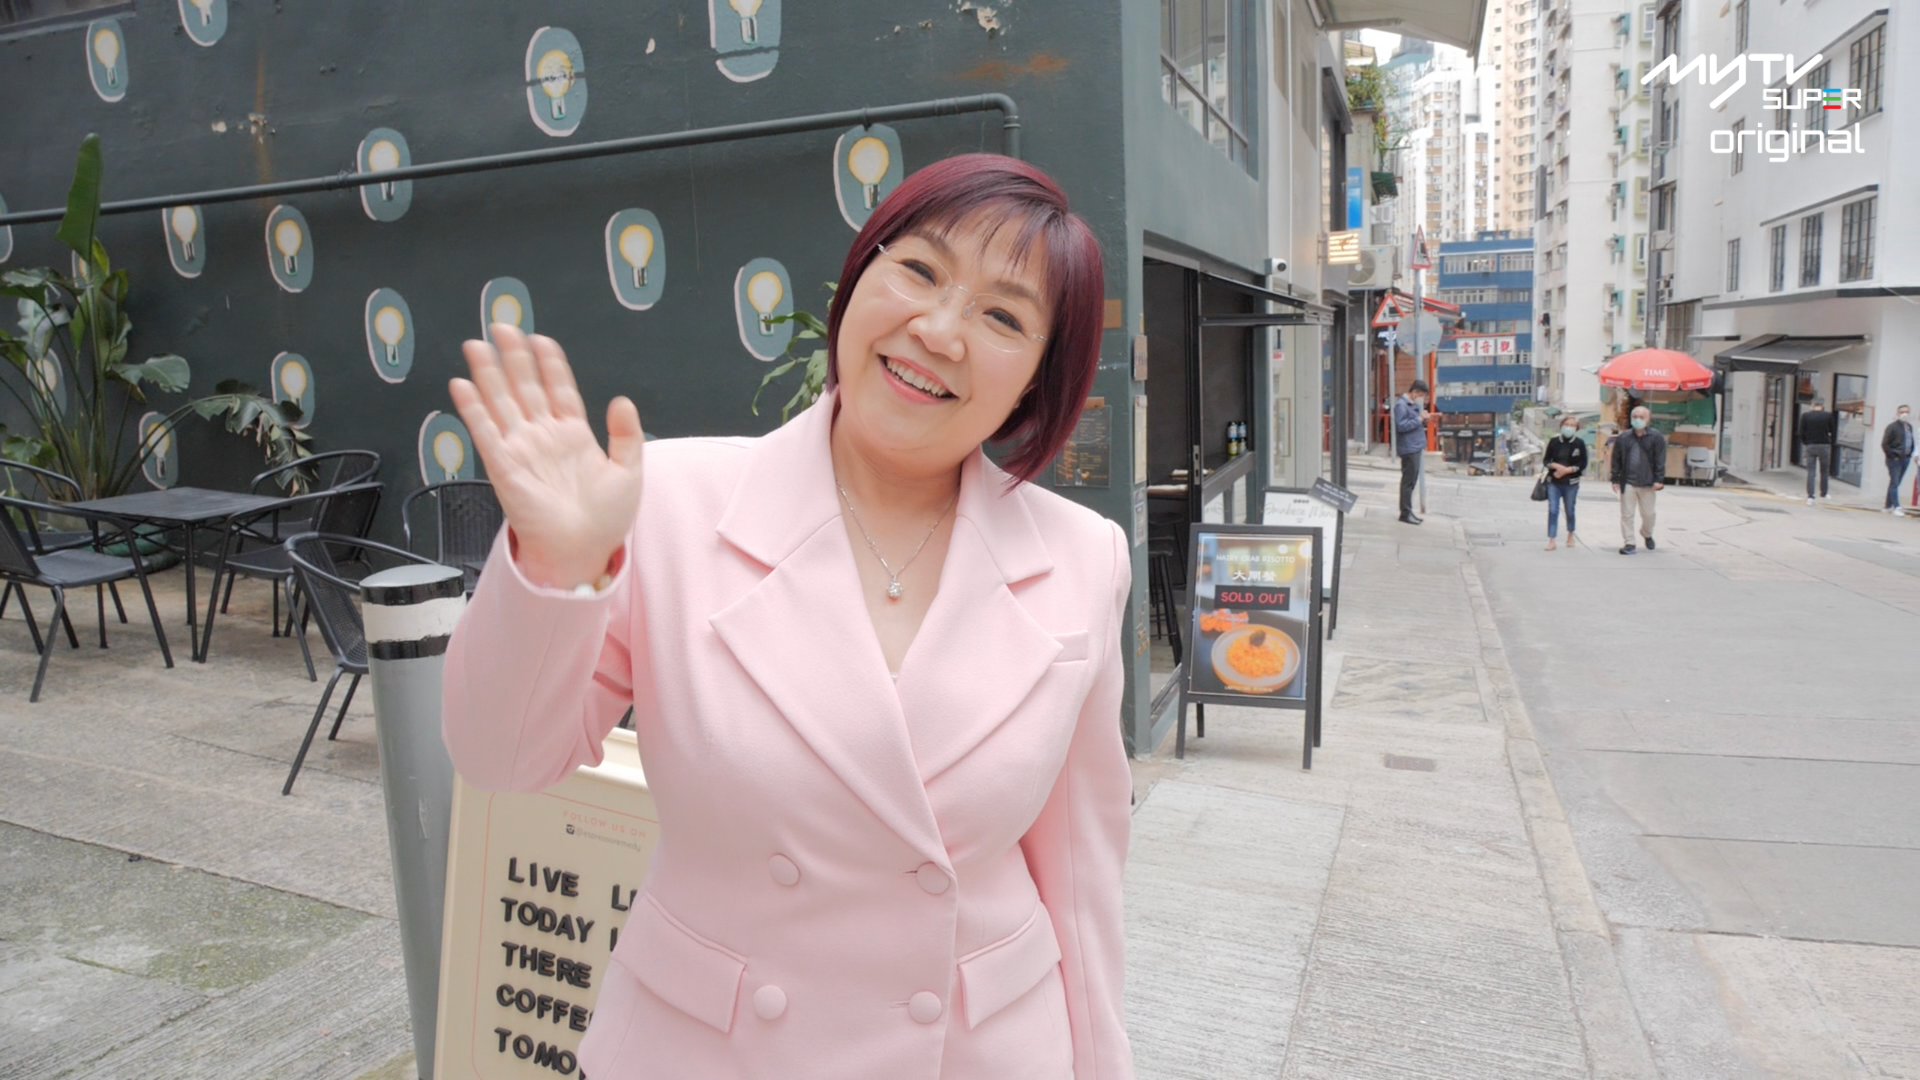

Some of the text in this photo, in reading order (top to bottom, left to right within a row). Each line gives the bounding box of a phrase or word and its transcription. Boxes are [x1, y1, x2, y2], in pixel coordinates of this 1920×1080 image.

[1643, 368, 1670, 377] TIME
[1216, 554, 1238, 562] HAIRY
[1262, 555, 1296, 563] RISOTTO
[1221, 591, 1285, 604] SOLD OUT
[563, 810, 646, 838] FOLLOW US ON
[508, 857, 579, 897] LIVE
[500, 897, 595, 943] TODAY
[501, 941, 592, 989] THERE
[496, 983, 593, 1032] COFFE
[494, 1027, 586, 1080] TOMO
